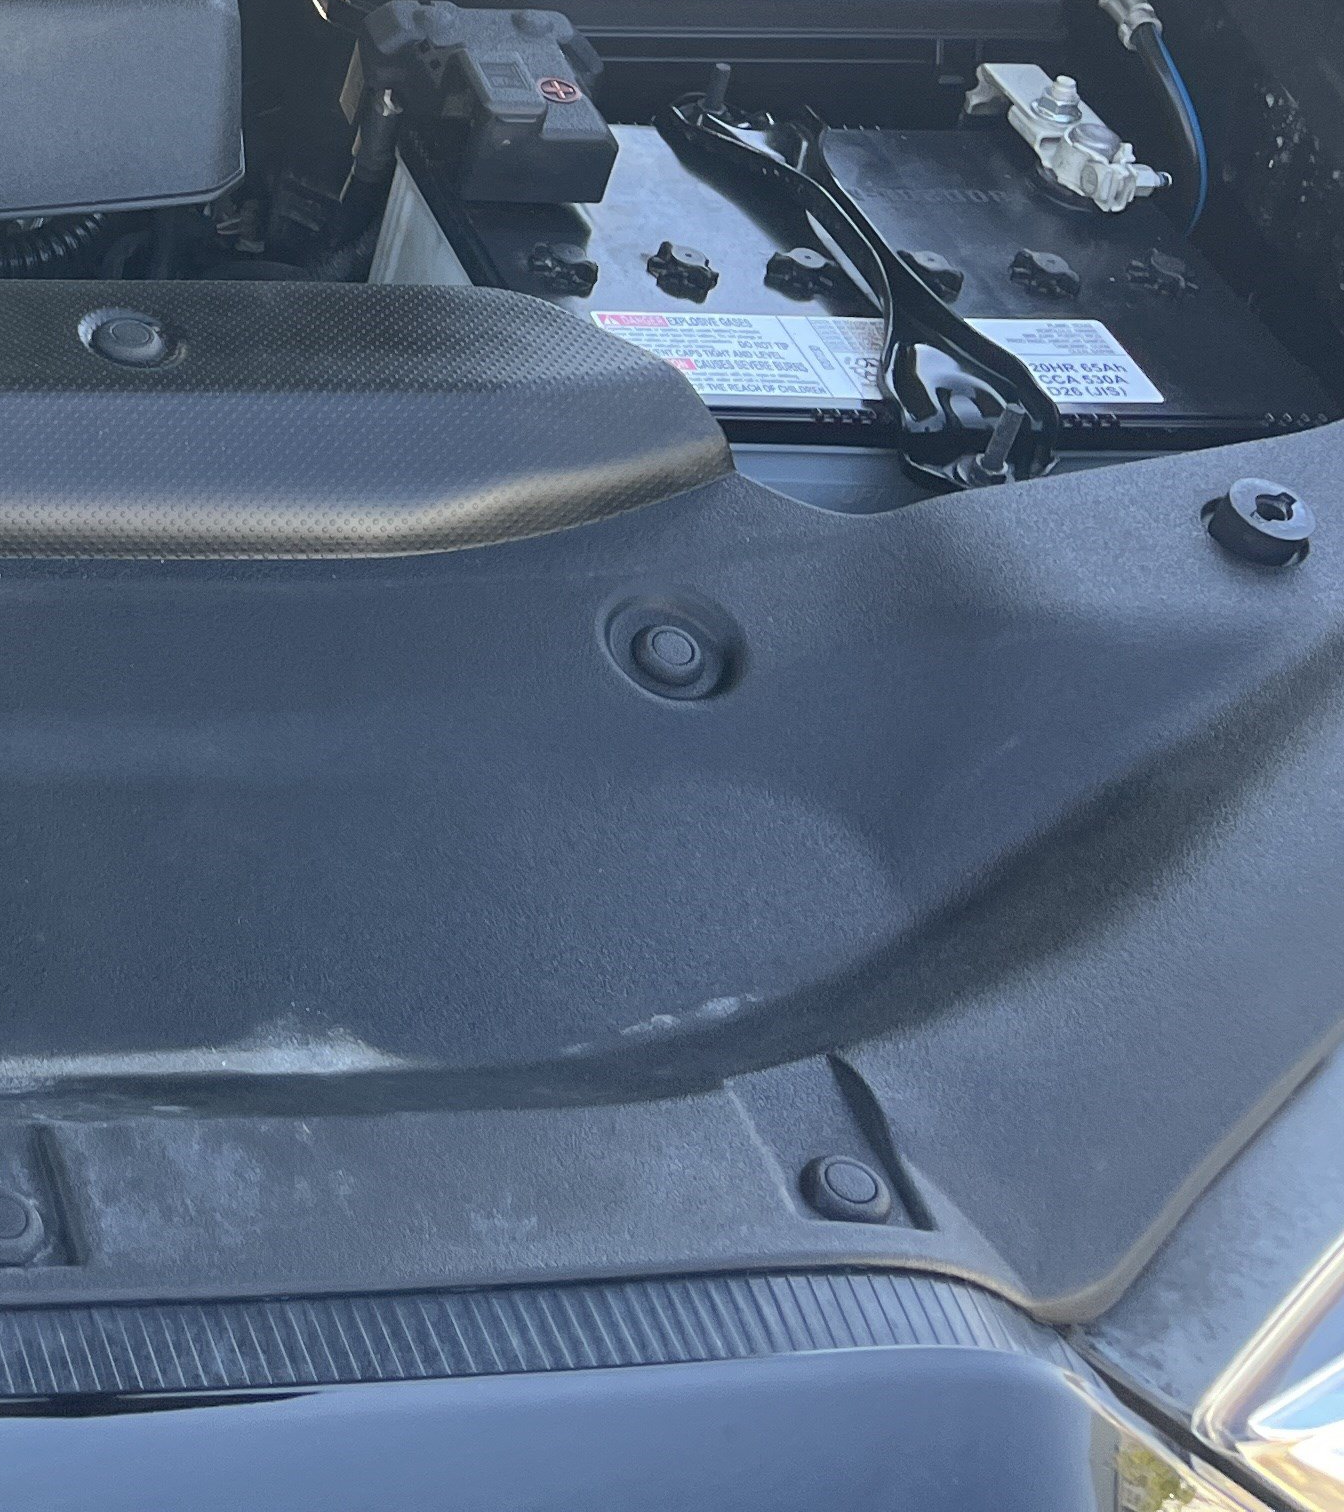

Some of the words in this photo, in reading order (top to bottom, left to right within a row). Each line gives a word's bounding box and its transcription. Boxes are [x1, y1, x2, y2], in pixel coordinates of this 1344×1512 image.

[667, 317, 718, 327] EXPLOSIVE
[1081, 363, 1128, 373] 65Ah
[1039, 375, 1082, 385] CCA
[1083, 375, 1130, 385] 530A
[1086, 387, 1128, 397] (JIS)
